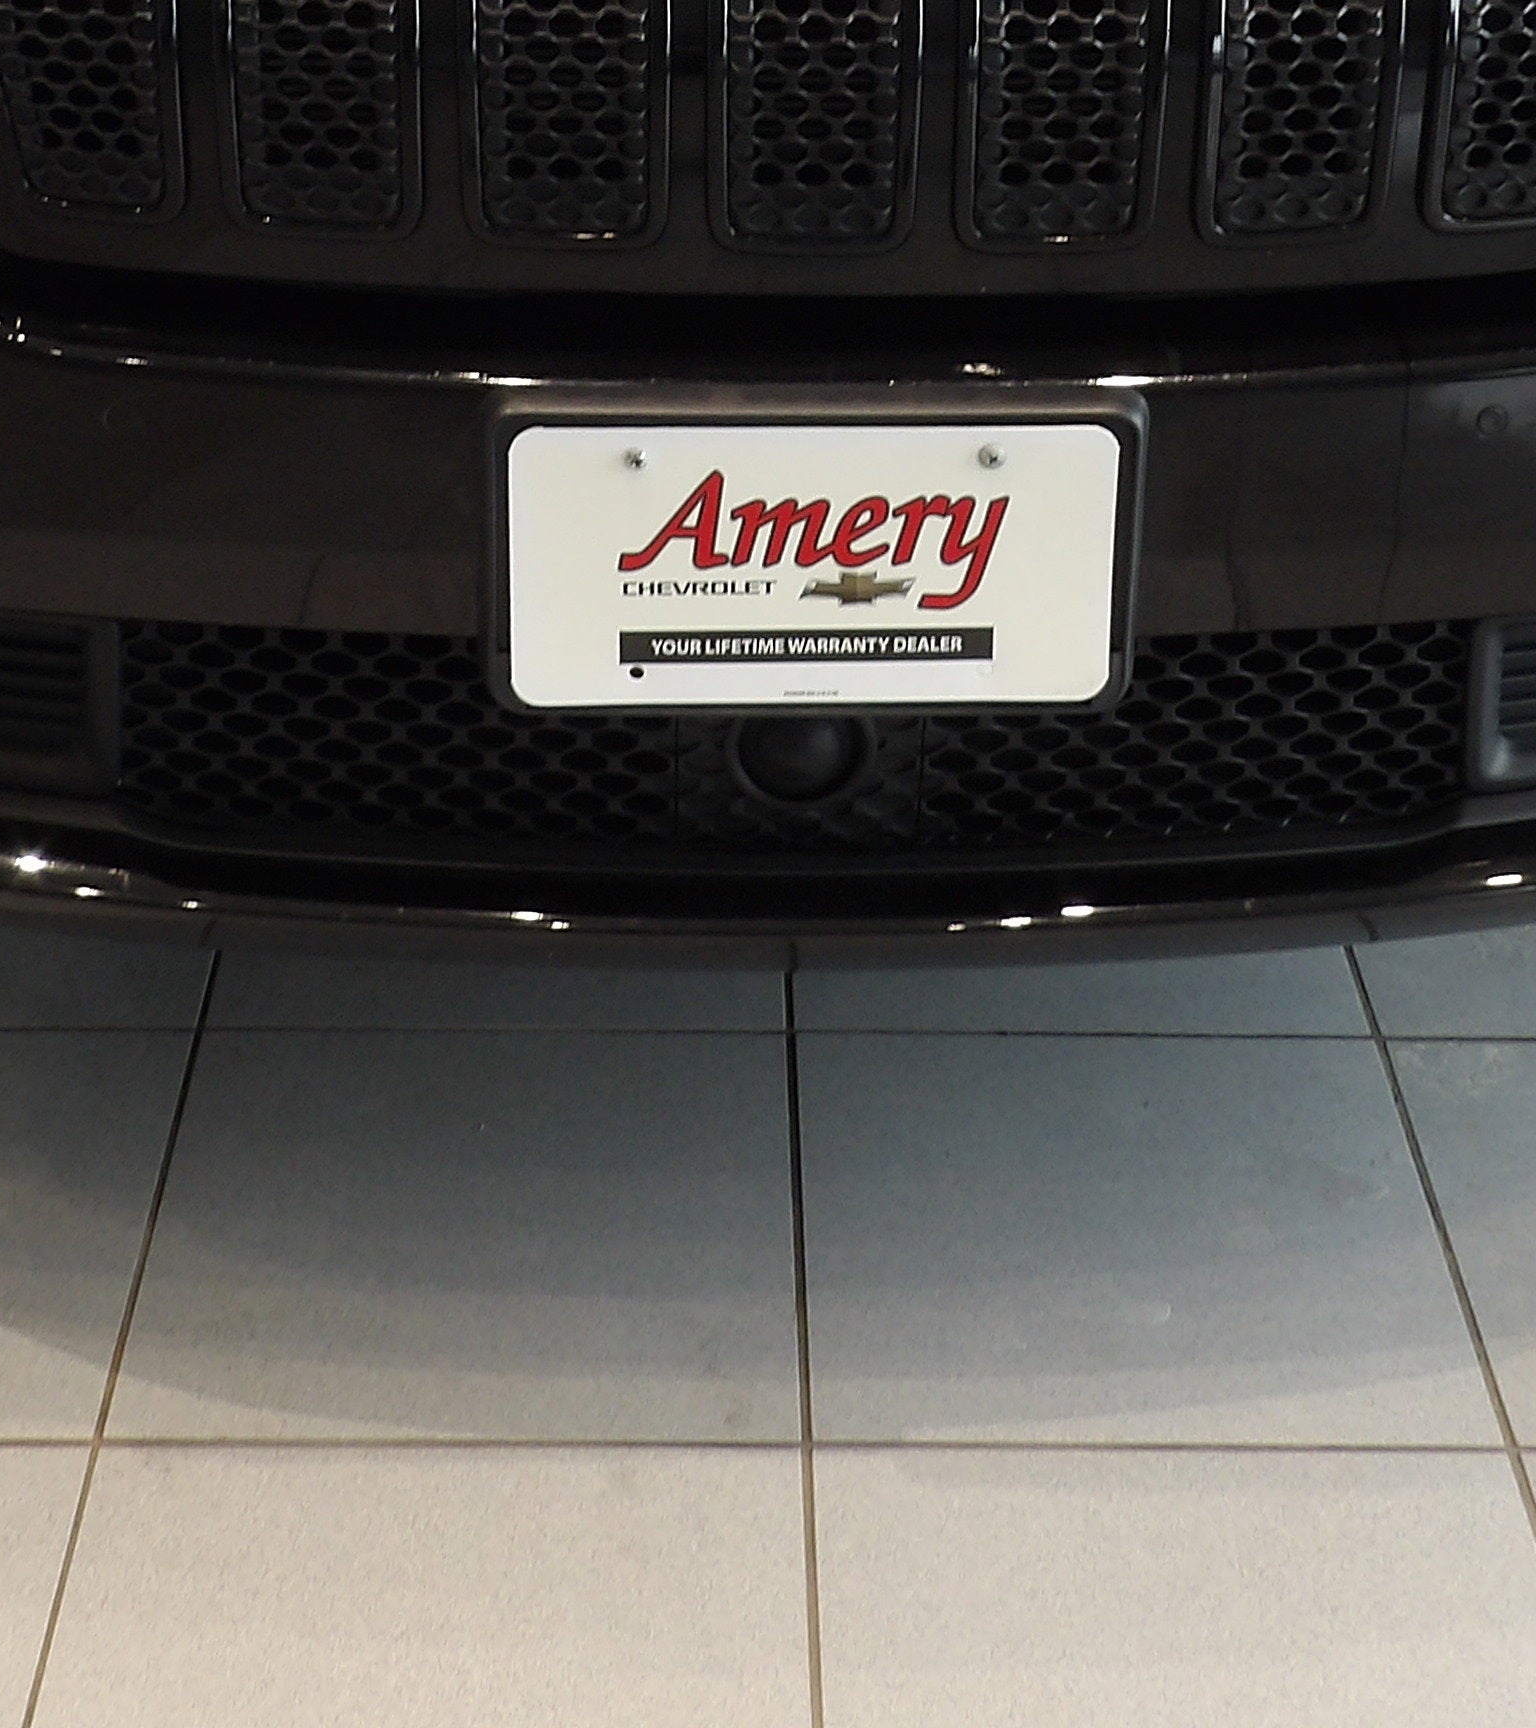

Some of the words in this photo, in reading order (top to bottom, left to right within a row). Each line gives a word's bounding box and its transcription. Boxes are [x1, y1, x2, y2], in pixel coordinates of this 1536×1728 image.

[618, 469, 1010, 610] Amery
[622, 580, 777, 597] CHEVROLET
[651, 638, 702, 655] YOUR
[705, 637, 784, 654] LIFETIME
[787, 636, 890, 654] WARRANTY
[893, 635, 963, 653] DEALER
